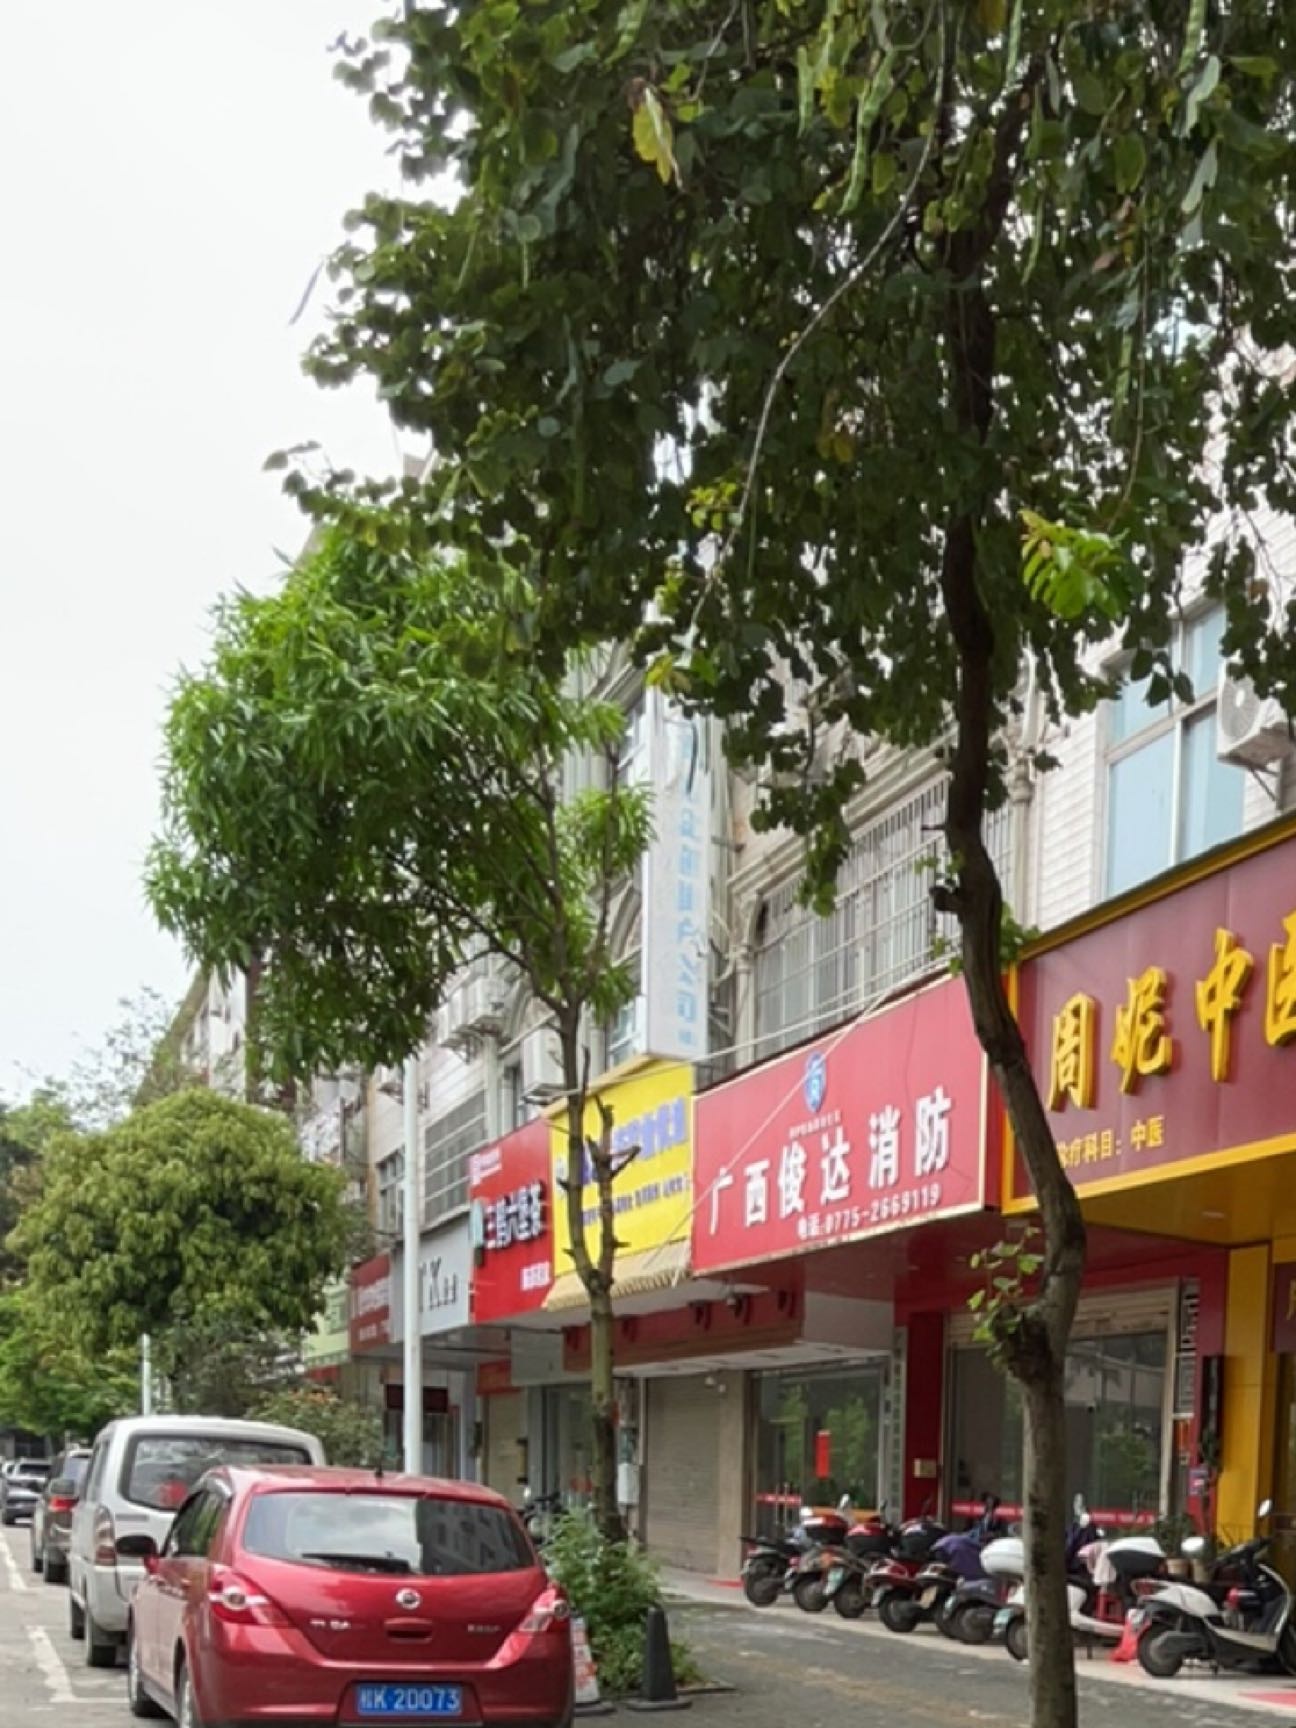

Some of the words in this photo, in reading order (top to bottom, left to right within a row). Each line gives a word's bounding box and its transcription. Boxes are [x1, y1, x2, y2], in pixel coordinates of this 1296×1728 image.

[709, 1085, 952, 1236] 广西俊达消防
